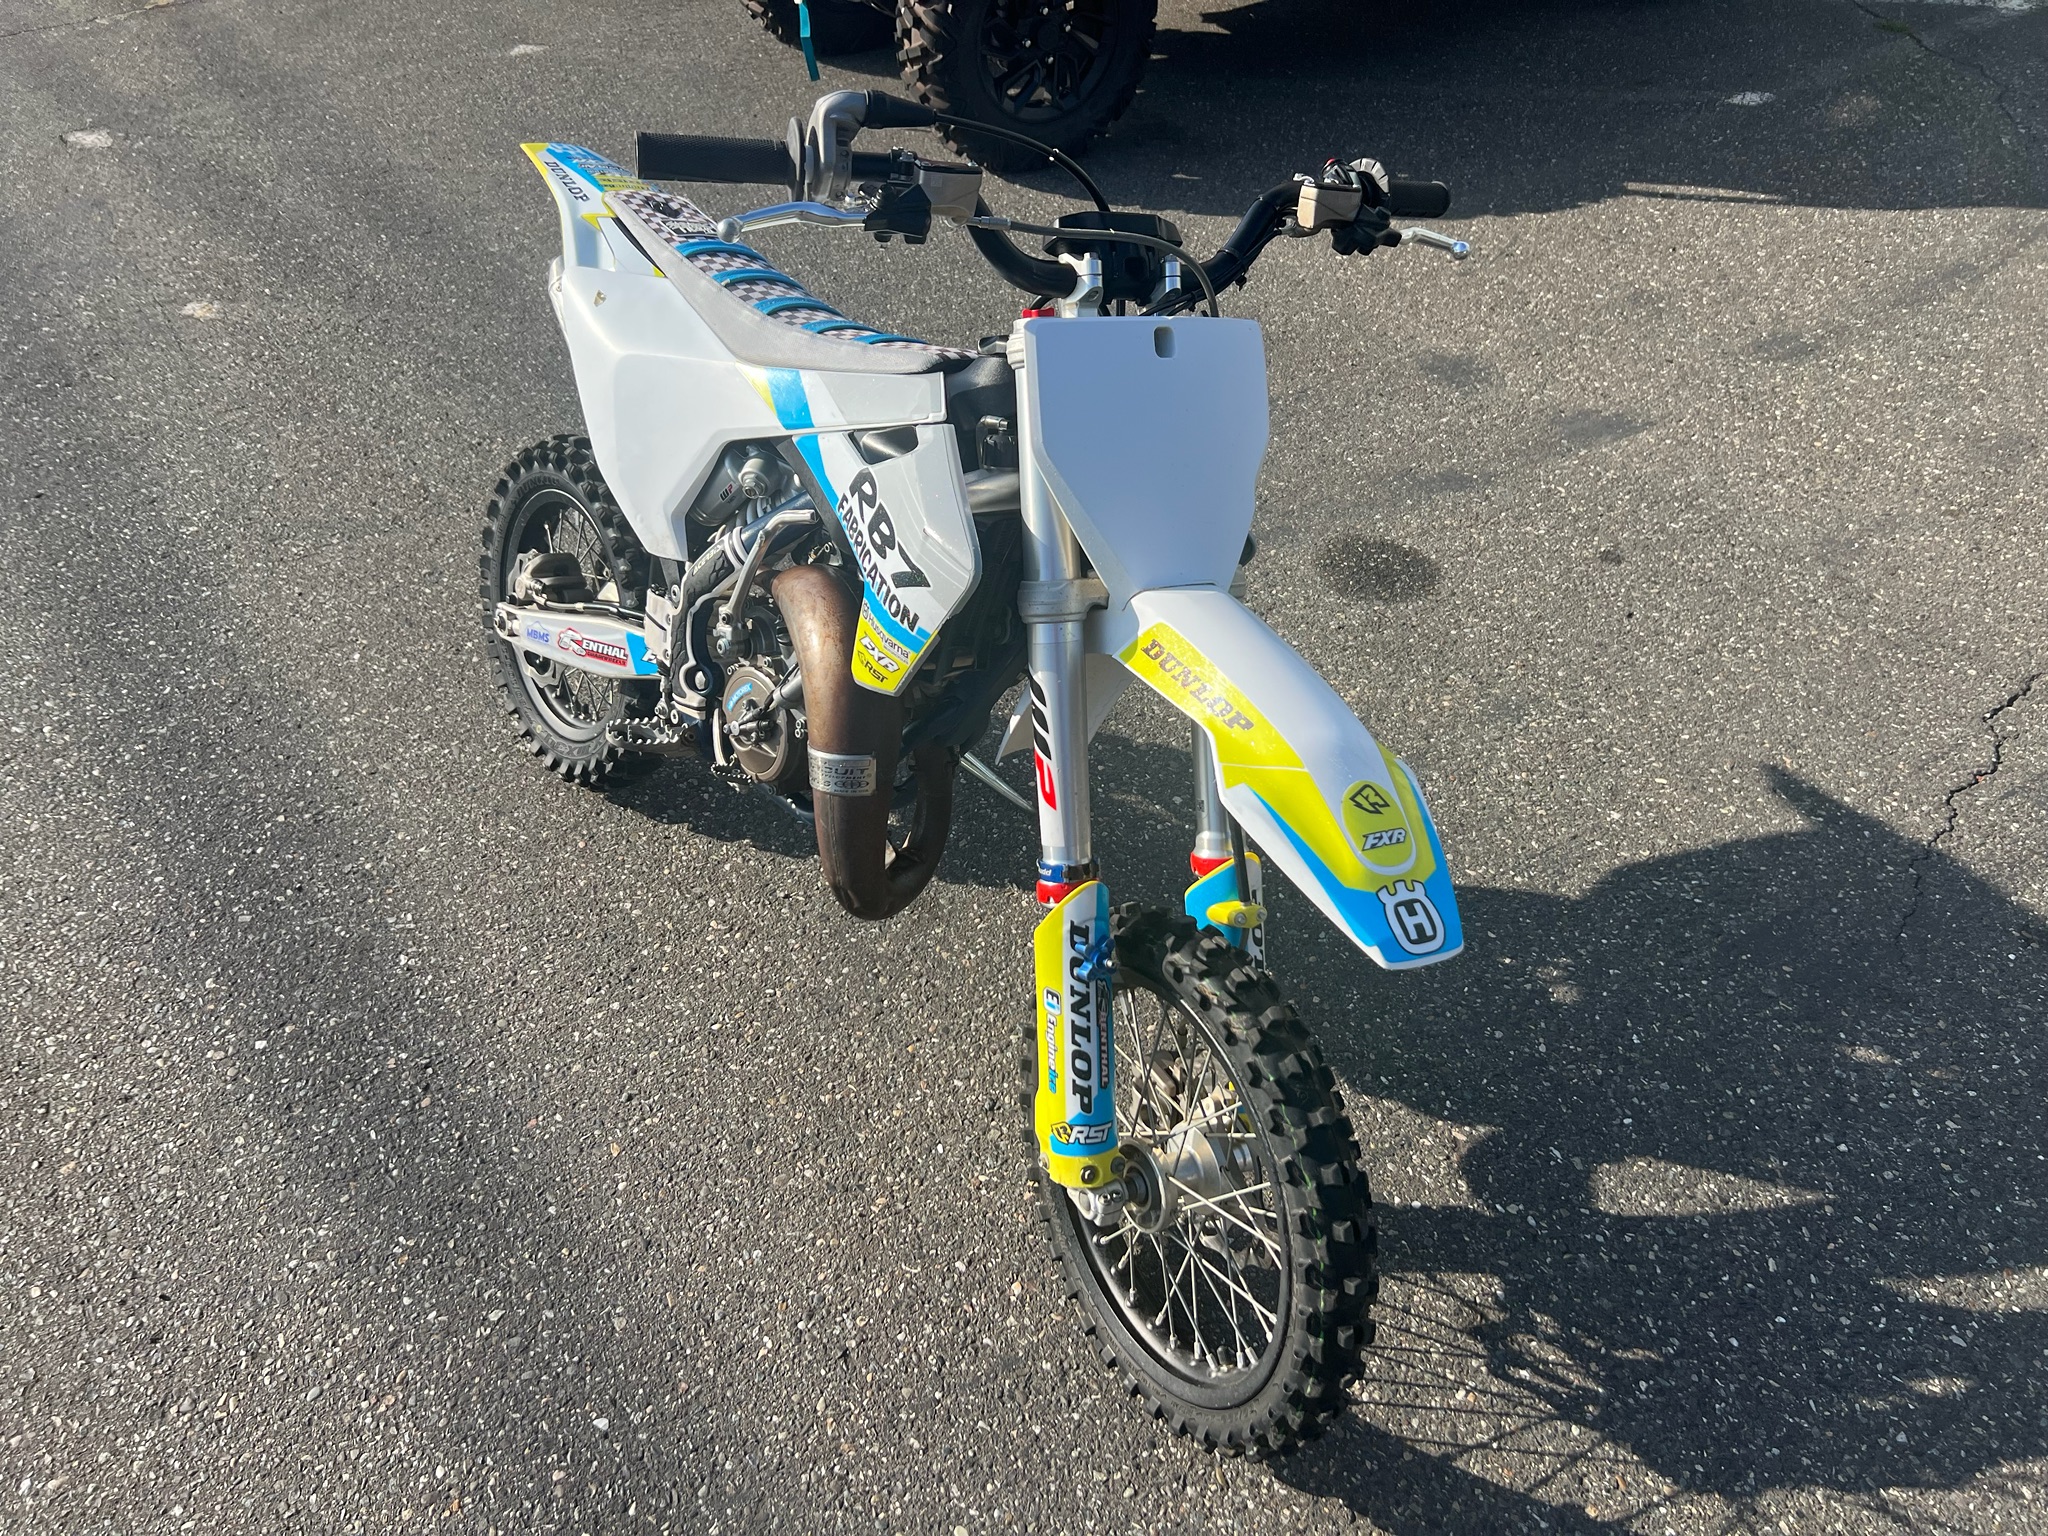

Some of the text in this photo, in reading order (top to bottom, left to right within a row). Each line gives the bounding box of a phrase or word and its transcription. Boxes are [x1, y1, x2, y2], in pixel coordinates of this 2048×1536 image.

[544, 161, 590, 203] DUNLOP
[720, 484, 733, 501] WP
[849, 467, 931, 589] RB7
[837, 493, 920, 632] FABRICATION
[527, 628, 550, 643] MBMS
[859, 634, 900, 673] FXR
[868, 612, 910, 659] Husqvarna
[865, 661, 888, 683] RST
[1140, 638, 1254, 731] DUNLOP
[1362, 828, 1407, 851] FXR
[1070, 920, 1093, 1114] DUNLOP
[1069, 1121, 1112, 1145] RST
